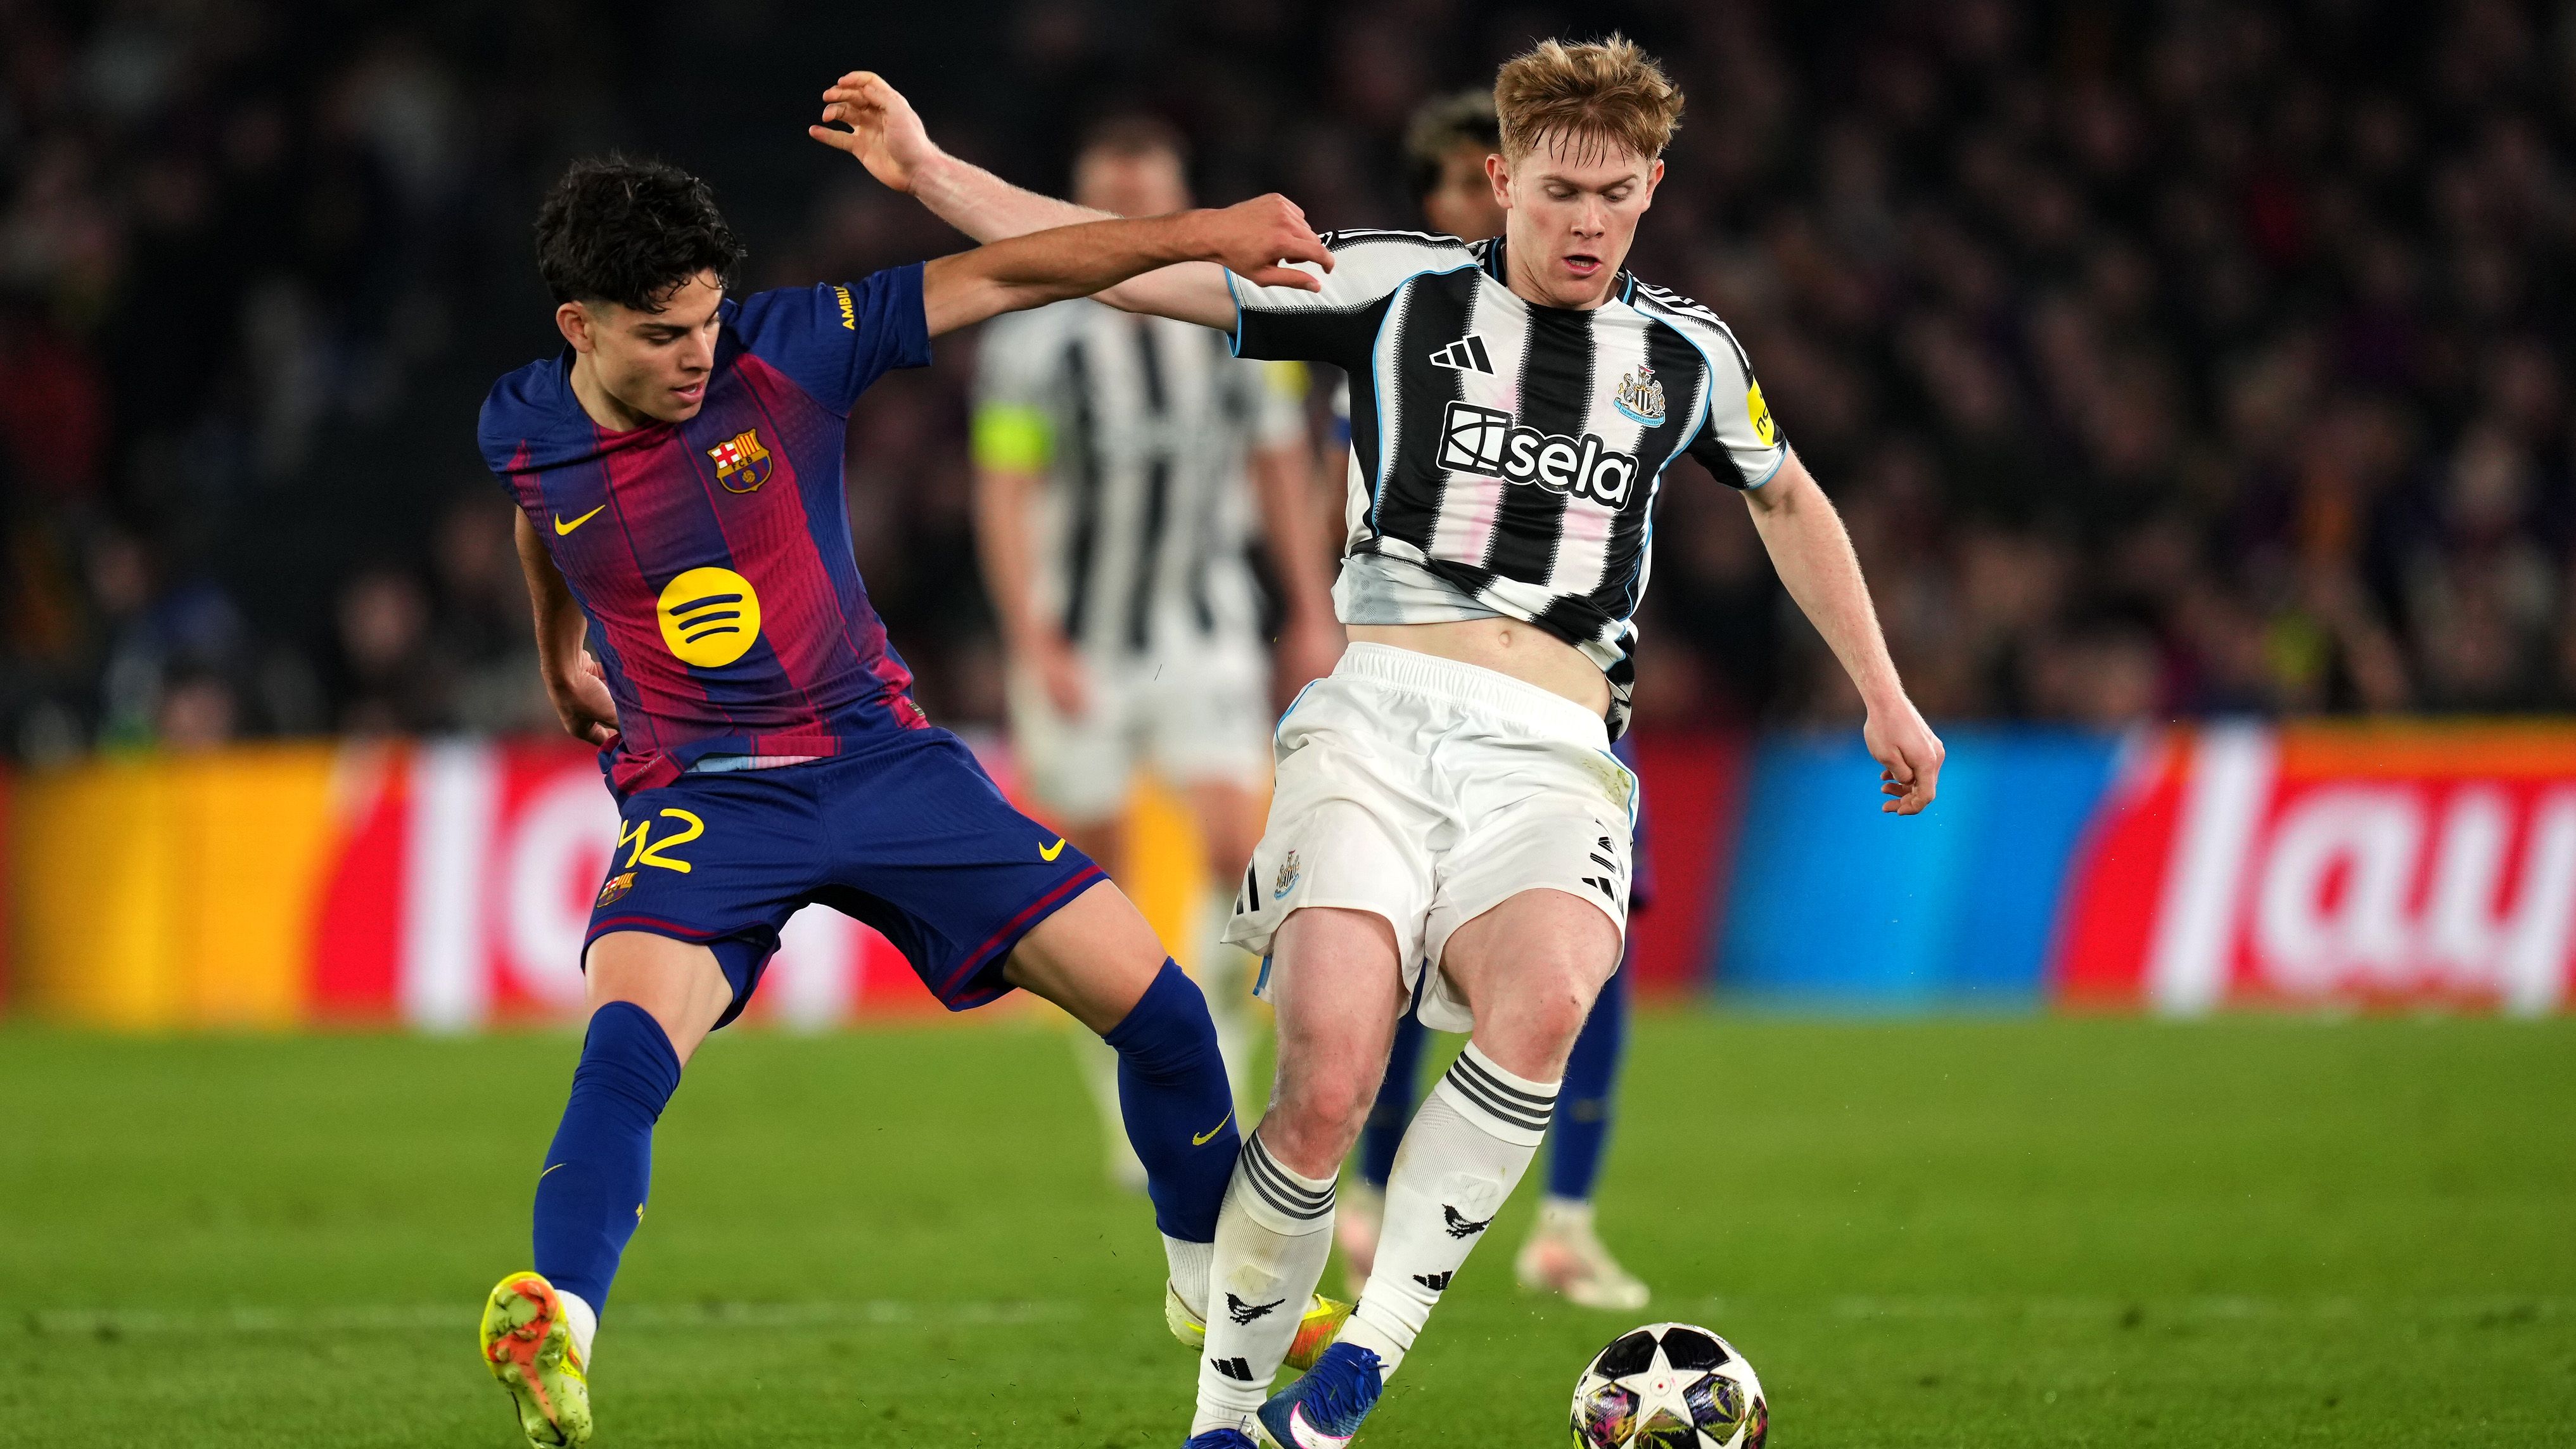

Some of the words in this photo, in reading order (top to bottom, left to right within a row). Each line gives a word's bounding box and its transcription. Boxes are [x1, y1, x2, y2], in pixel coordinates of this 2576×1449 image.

[833, 286, 855, 329] AMBILI
[1621, 408, 1645, 423] NEWCASTLE
[1505, 435, 1633, 503] sela
[617, 808, 705, 874] 42
